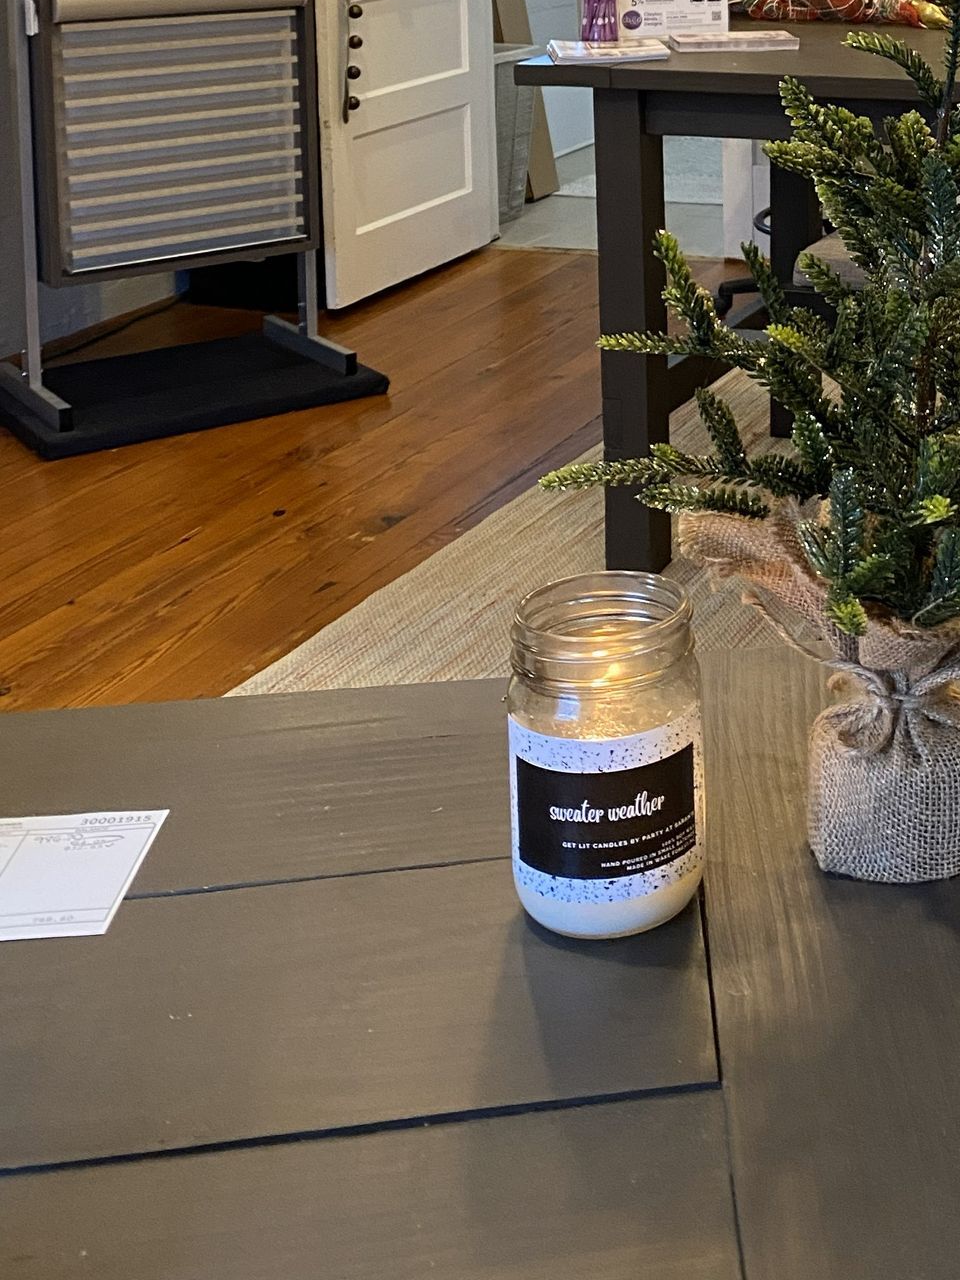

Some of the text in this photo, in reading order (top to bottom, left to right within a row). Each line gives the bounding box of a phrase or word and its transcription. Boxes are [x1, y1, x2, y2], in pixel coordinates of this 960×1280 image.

[549, 790, 665, 824] sweater weather
[80, 815, 153, 826] 30001915
[562, 841, 577, 849] GET
[592, 840, 628, 849] CANDLES
[630, 837, 641, 845] BY
[641, 829, 664, 842] PARTY
[664, 824, 673, 833] AT
[622, 854, 649, 866] POURED
[626, 862, 645, 870] MADE
